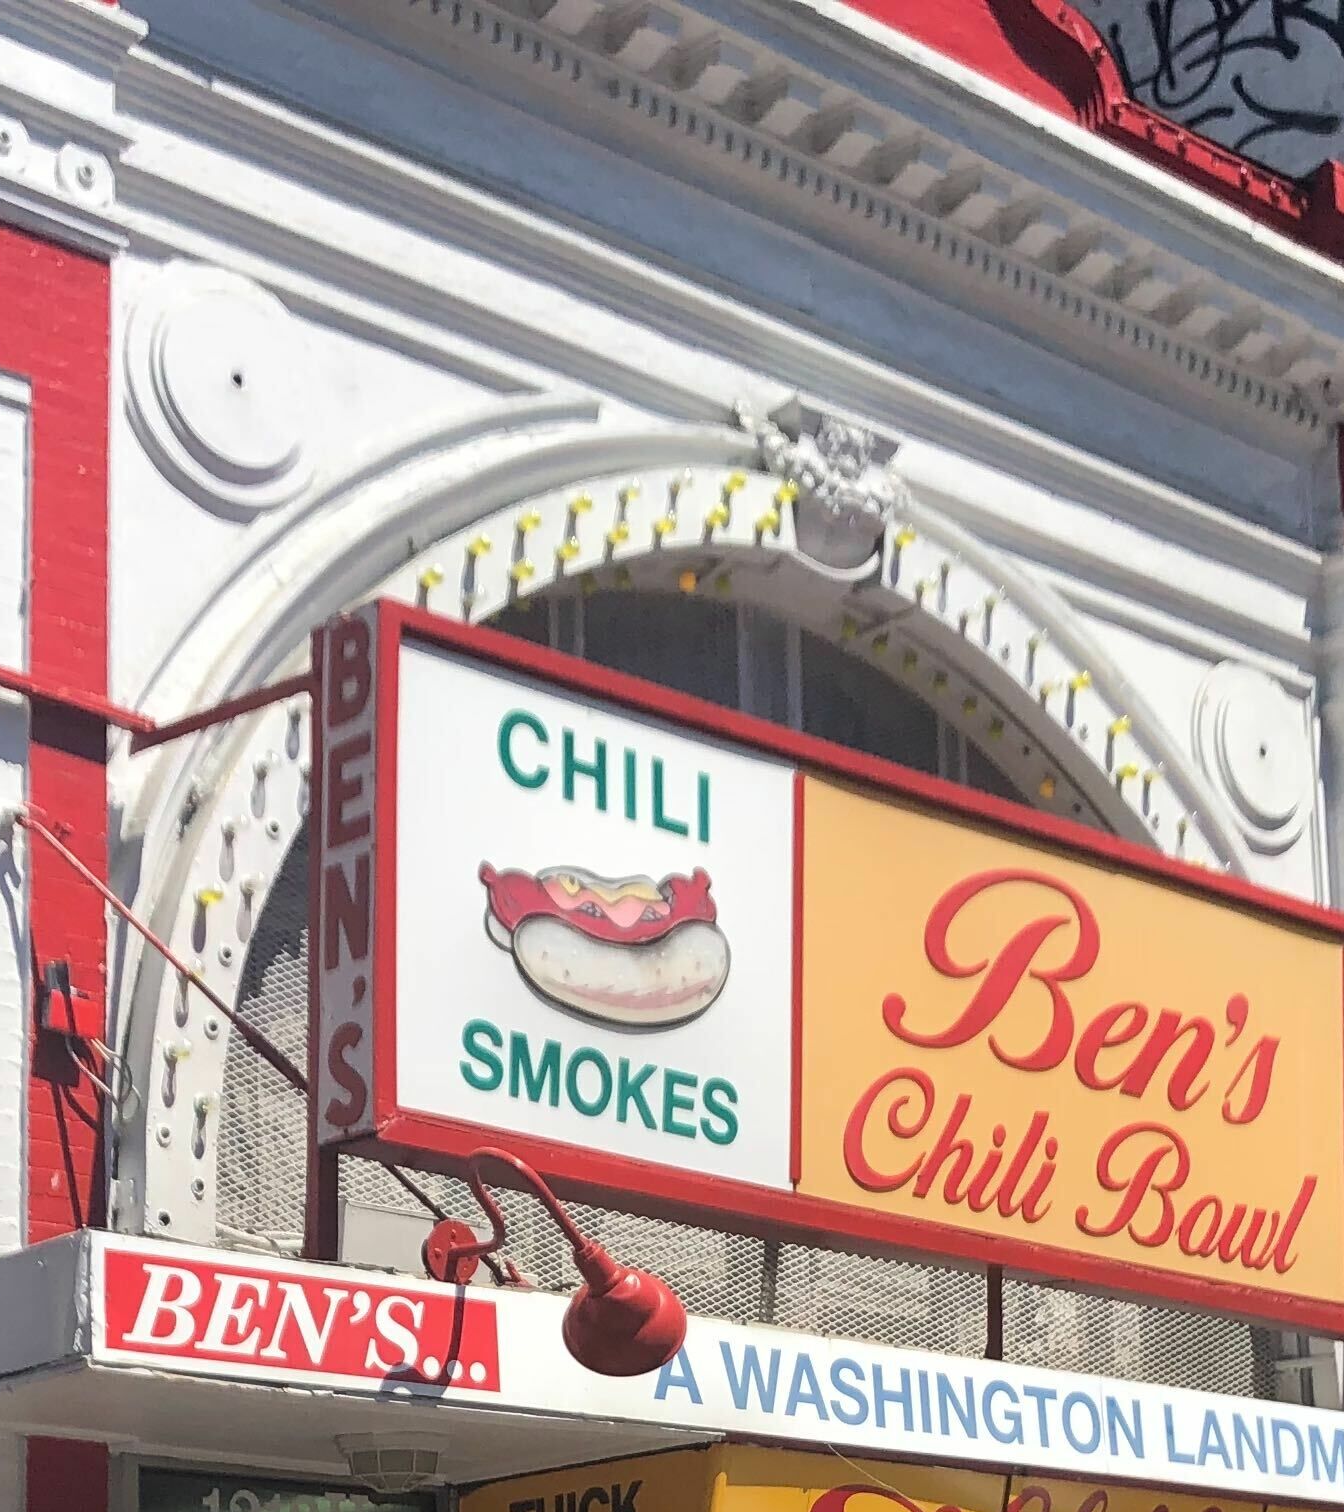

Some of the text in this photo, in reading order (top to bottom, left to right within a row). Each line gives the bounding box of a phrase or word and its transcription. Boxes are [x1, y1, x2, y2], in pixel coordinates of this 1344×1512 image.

[496, 708, 712, 845] CHILI
[882, 868, 1282, 1125] Ben's
[459, 1018, 741, 1146] SMOKES
[843, 1066, 1319, 1275] Chili Bowl
[654, 1342, 703, 1405] A
[719, 1341, 1145, 1460] WASHINGTON
